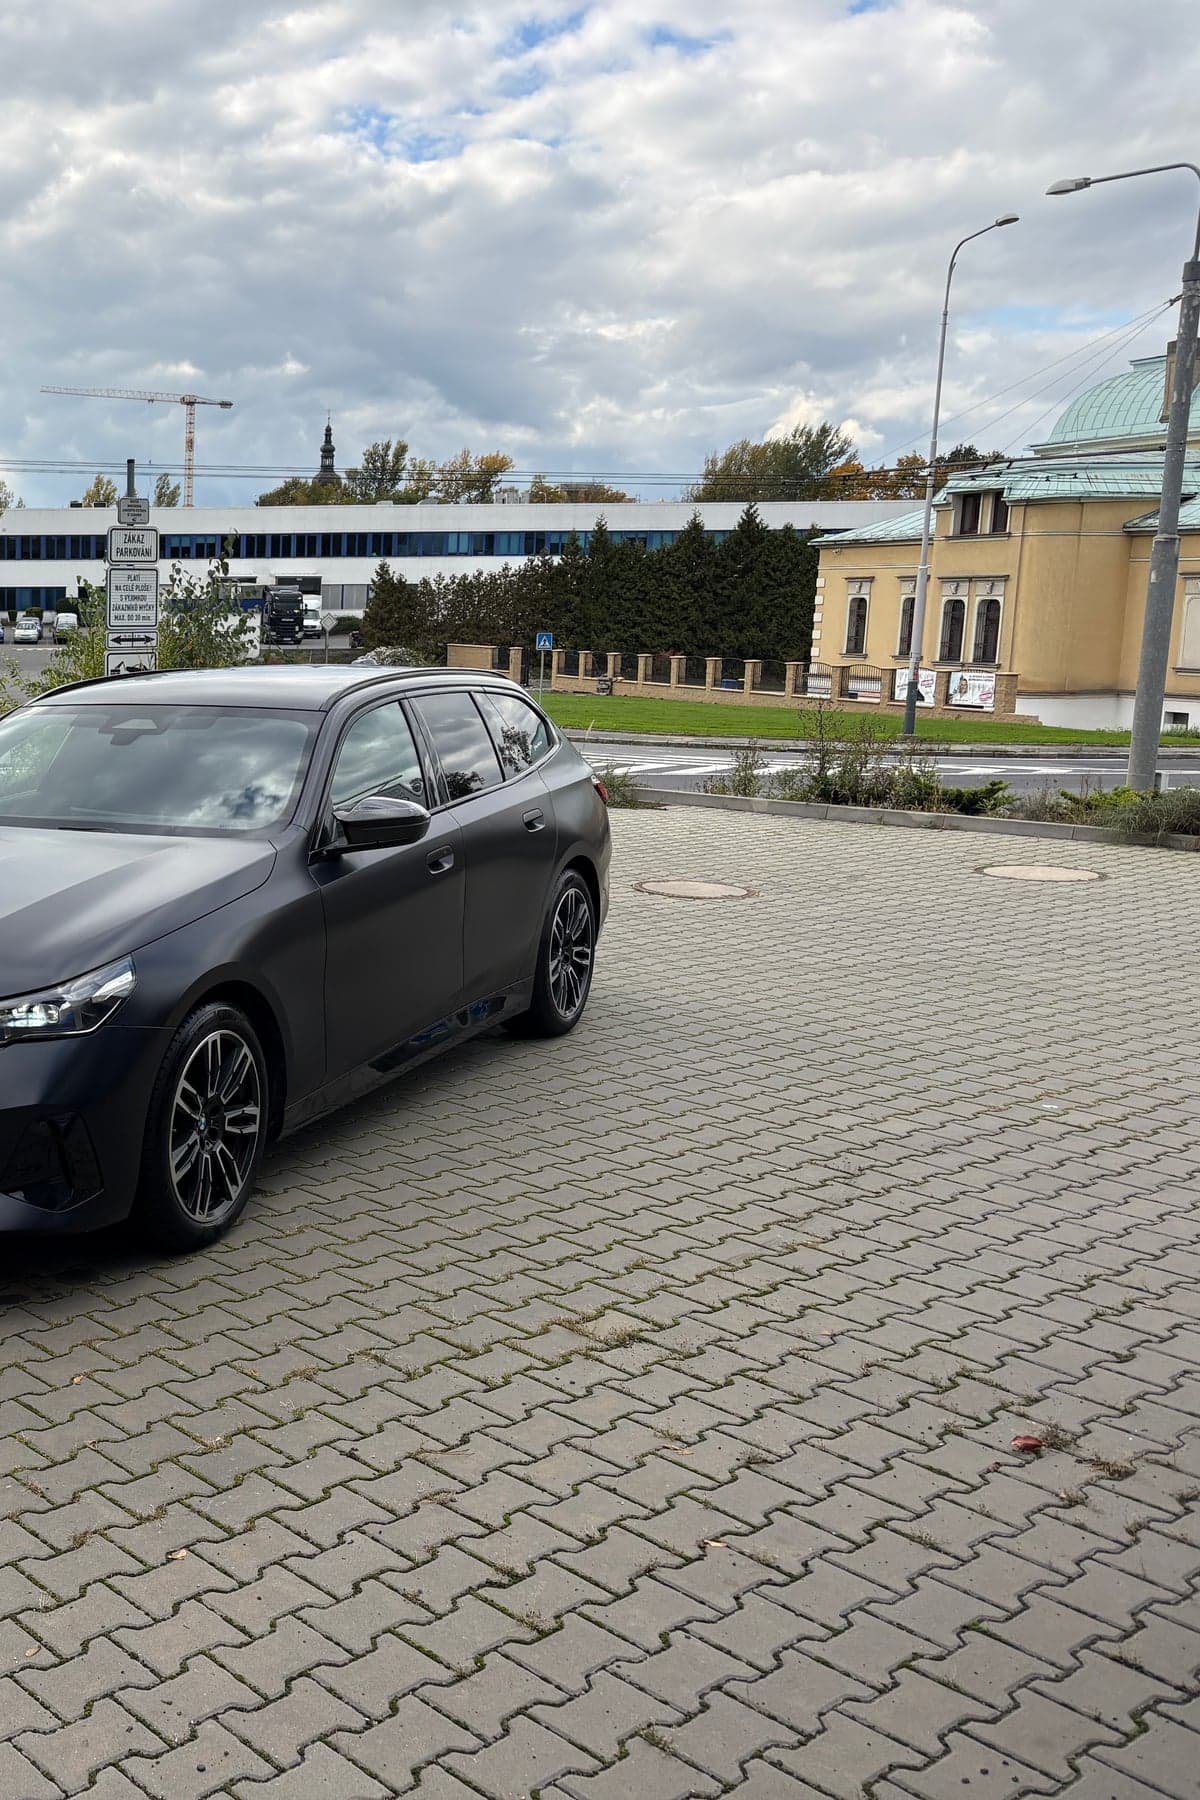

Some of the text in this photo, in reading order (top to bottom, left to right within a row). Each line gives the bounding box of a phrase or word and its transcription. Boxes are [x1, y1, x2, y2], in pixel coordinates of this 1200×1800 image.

[124, 532, 145, 544] ZÁKAZ
[116, 545, 152, 557] PARKOVÁNÍ
[123, 583, 134, 592] CELÉ
